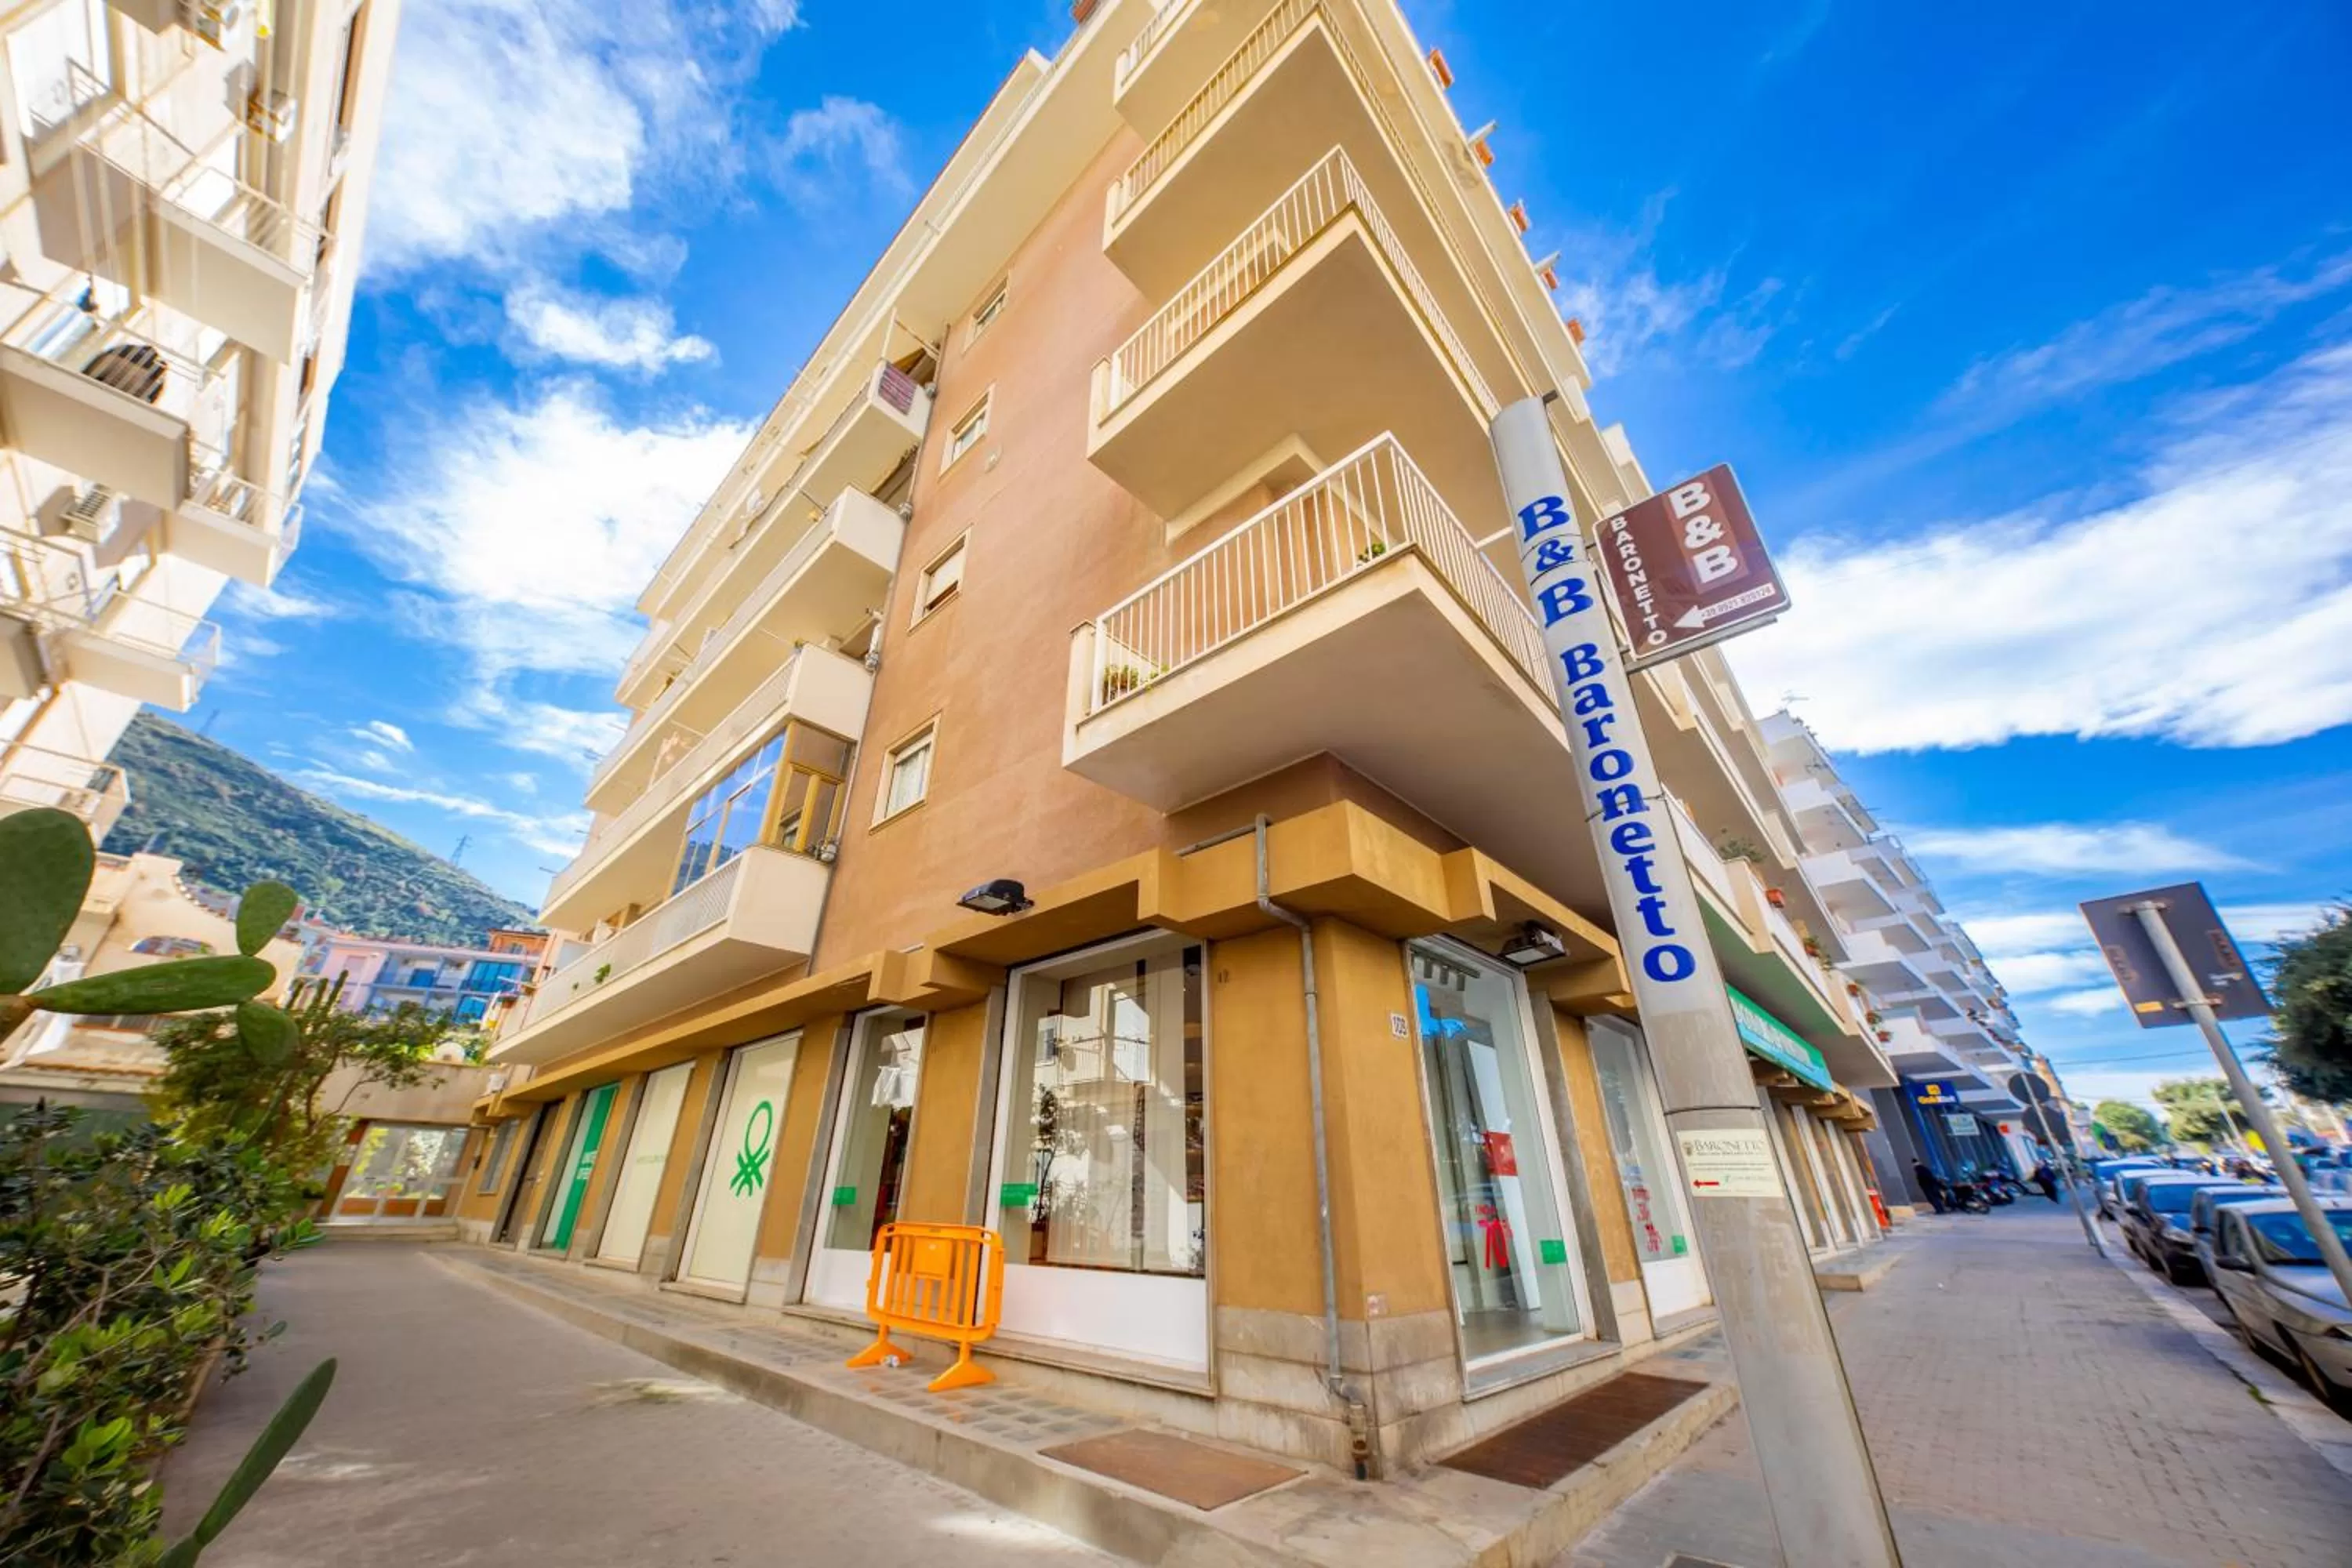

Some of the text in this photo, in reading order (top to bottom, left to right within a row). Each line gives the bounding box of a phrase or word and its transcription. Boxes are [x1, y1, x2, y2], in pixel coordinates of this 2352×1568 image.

[1610, 515, 1668, 646] BARONETTO
[1668, 481, 1739, 585] B&B
[1518, 495, 1697, 983] B&B Baronetto
